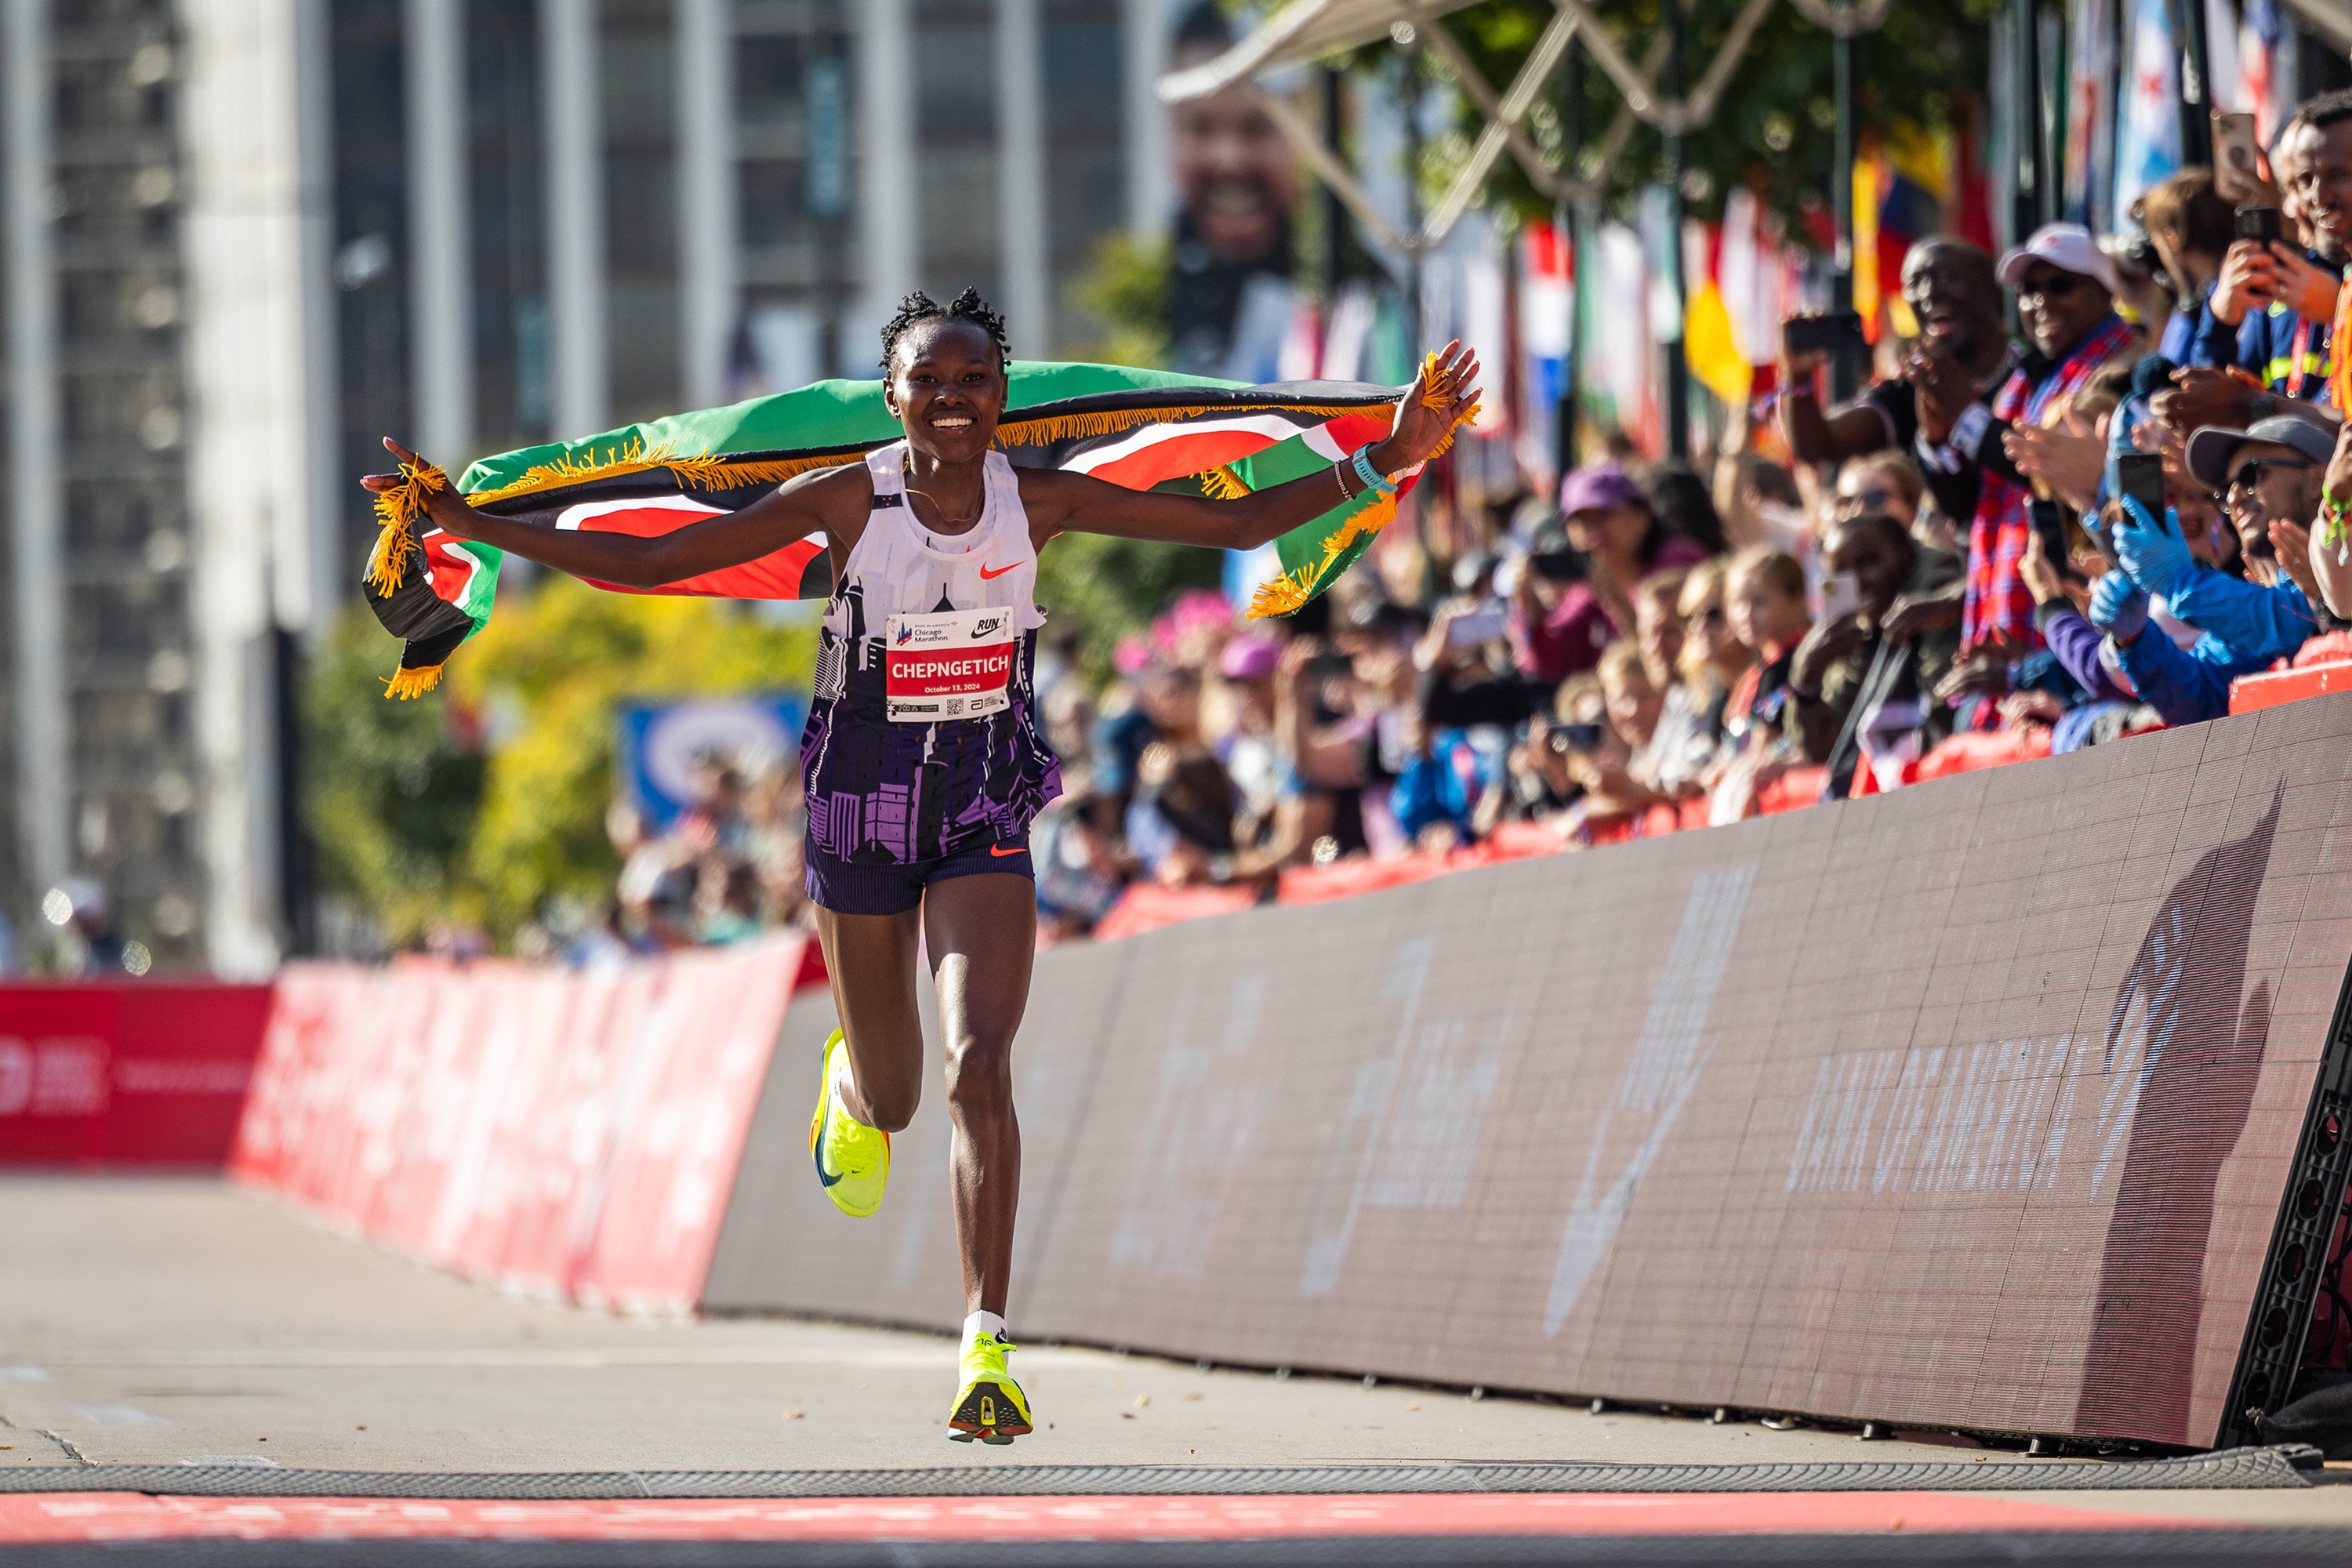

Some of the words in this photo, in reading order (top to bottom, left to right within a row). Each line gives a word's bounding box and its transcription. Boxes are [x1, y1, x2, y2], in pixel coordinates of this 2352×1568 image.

[977, 618, 1000, 630] RUN
[891, 655, 1009, 679] CHEPNGETICH
[924, 685, 951, 694] October
[1784, 1049, 1896, 1193] BANK
[1872, 1046, 1944, 1195] OF
[1911, 1032, 2089, 1192] AMERICA
